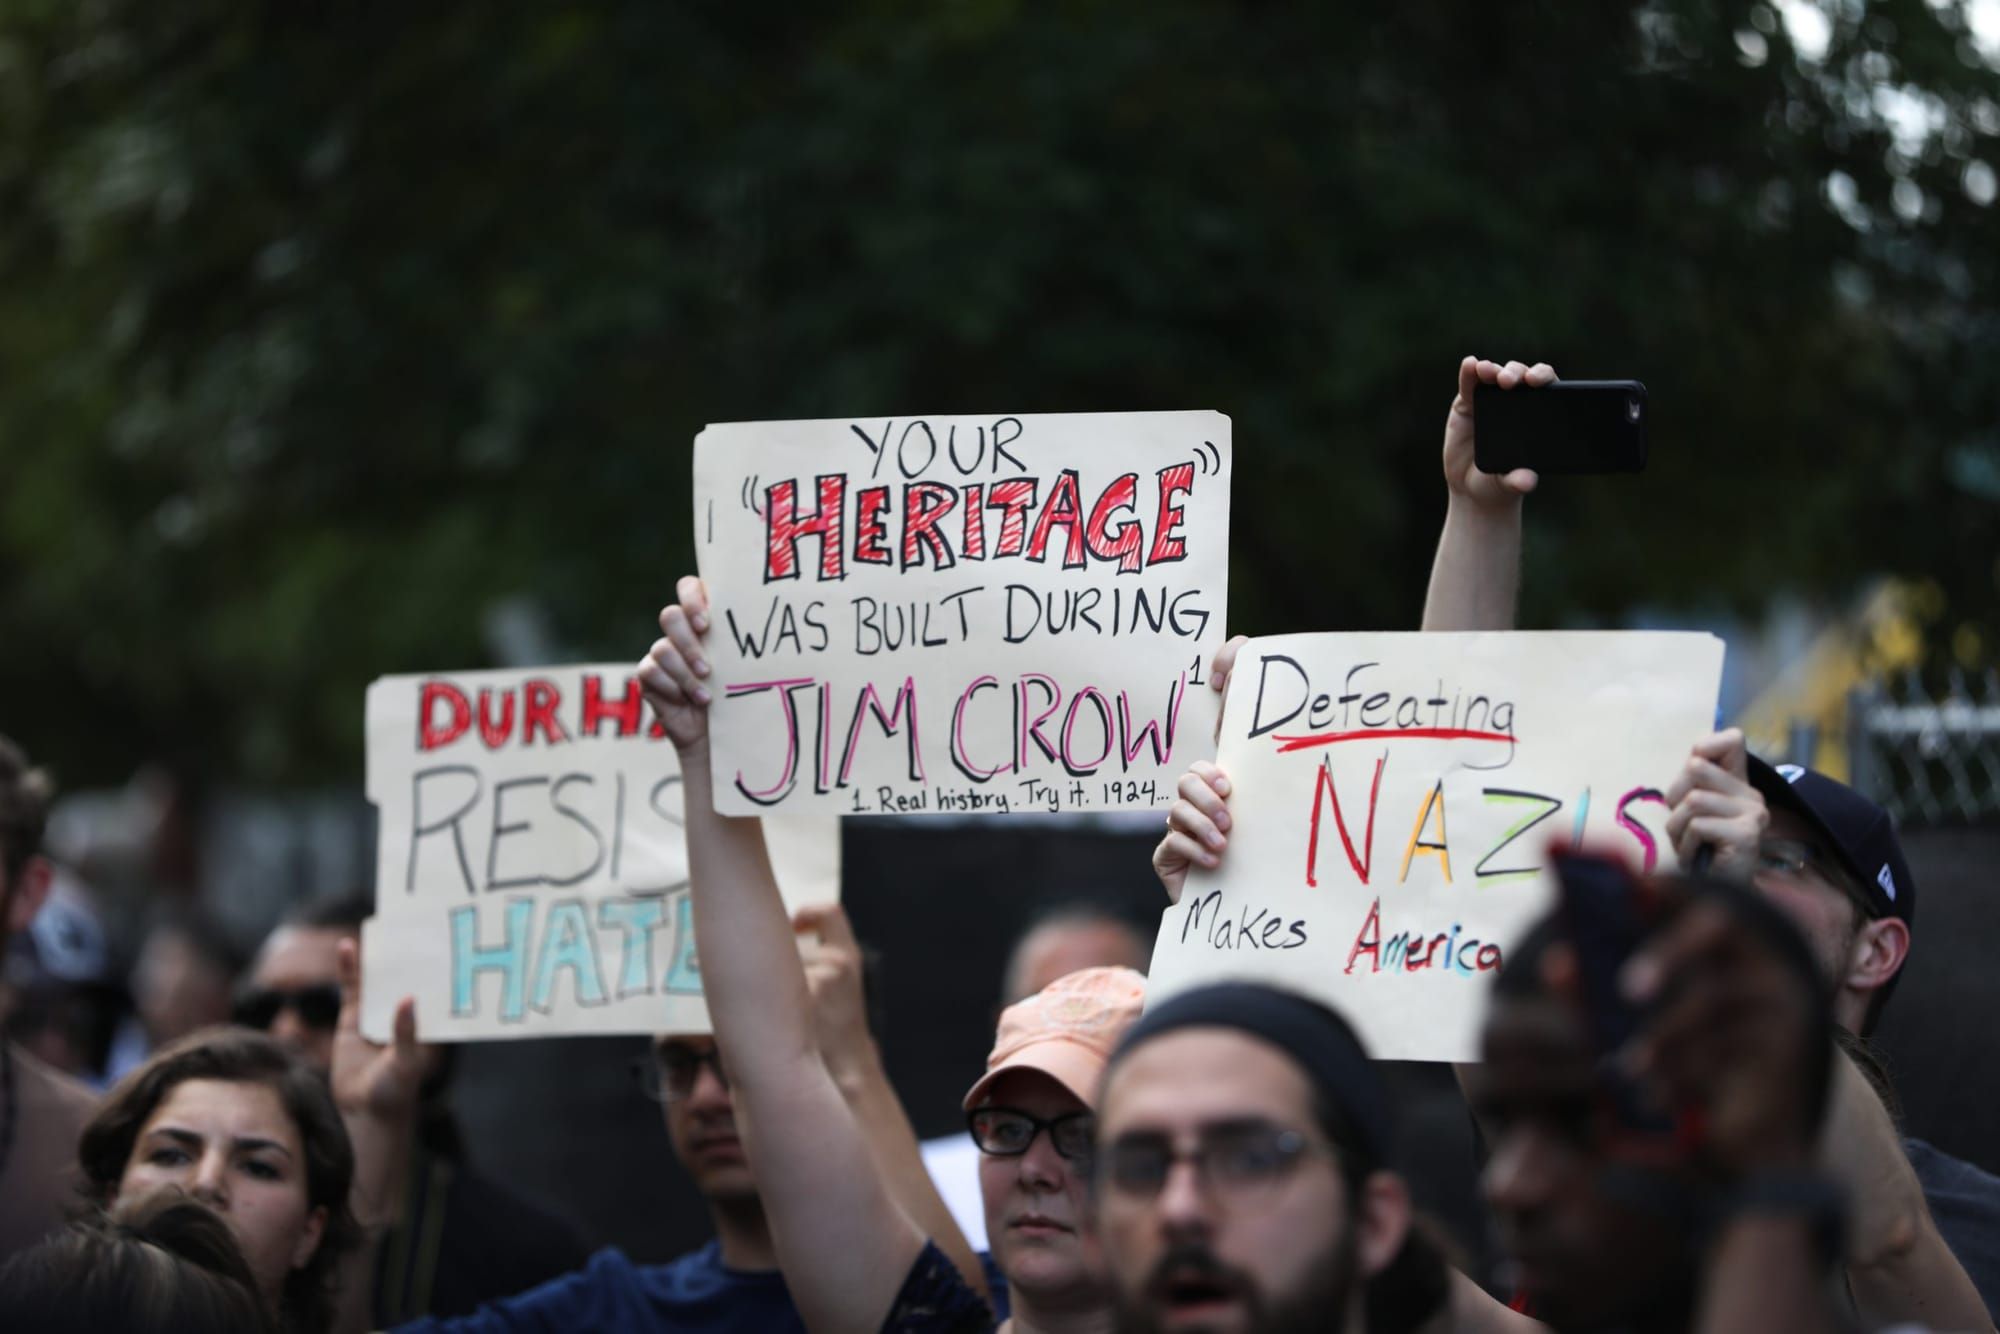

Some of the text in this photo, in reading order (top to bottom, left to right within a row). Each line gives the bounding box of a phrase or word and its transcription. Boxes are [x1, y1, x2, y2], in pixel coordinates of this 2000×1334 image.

[851, 417, 1027, 479] YOUR
[726, 584, 1210, 659] WAS BUILT DURING
[416, 675, 668, 752] DURH
[725, 676, 927, 807] JIM
[1248, 654, 1516, 769] Defeating
[878, 785, 927, 813] Real
[1020, 779, 1061, 813] Try
[1069, 781, 1090, 805] it.
